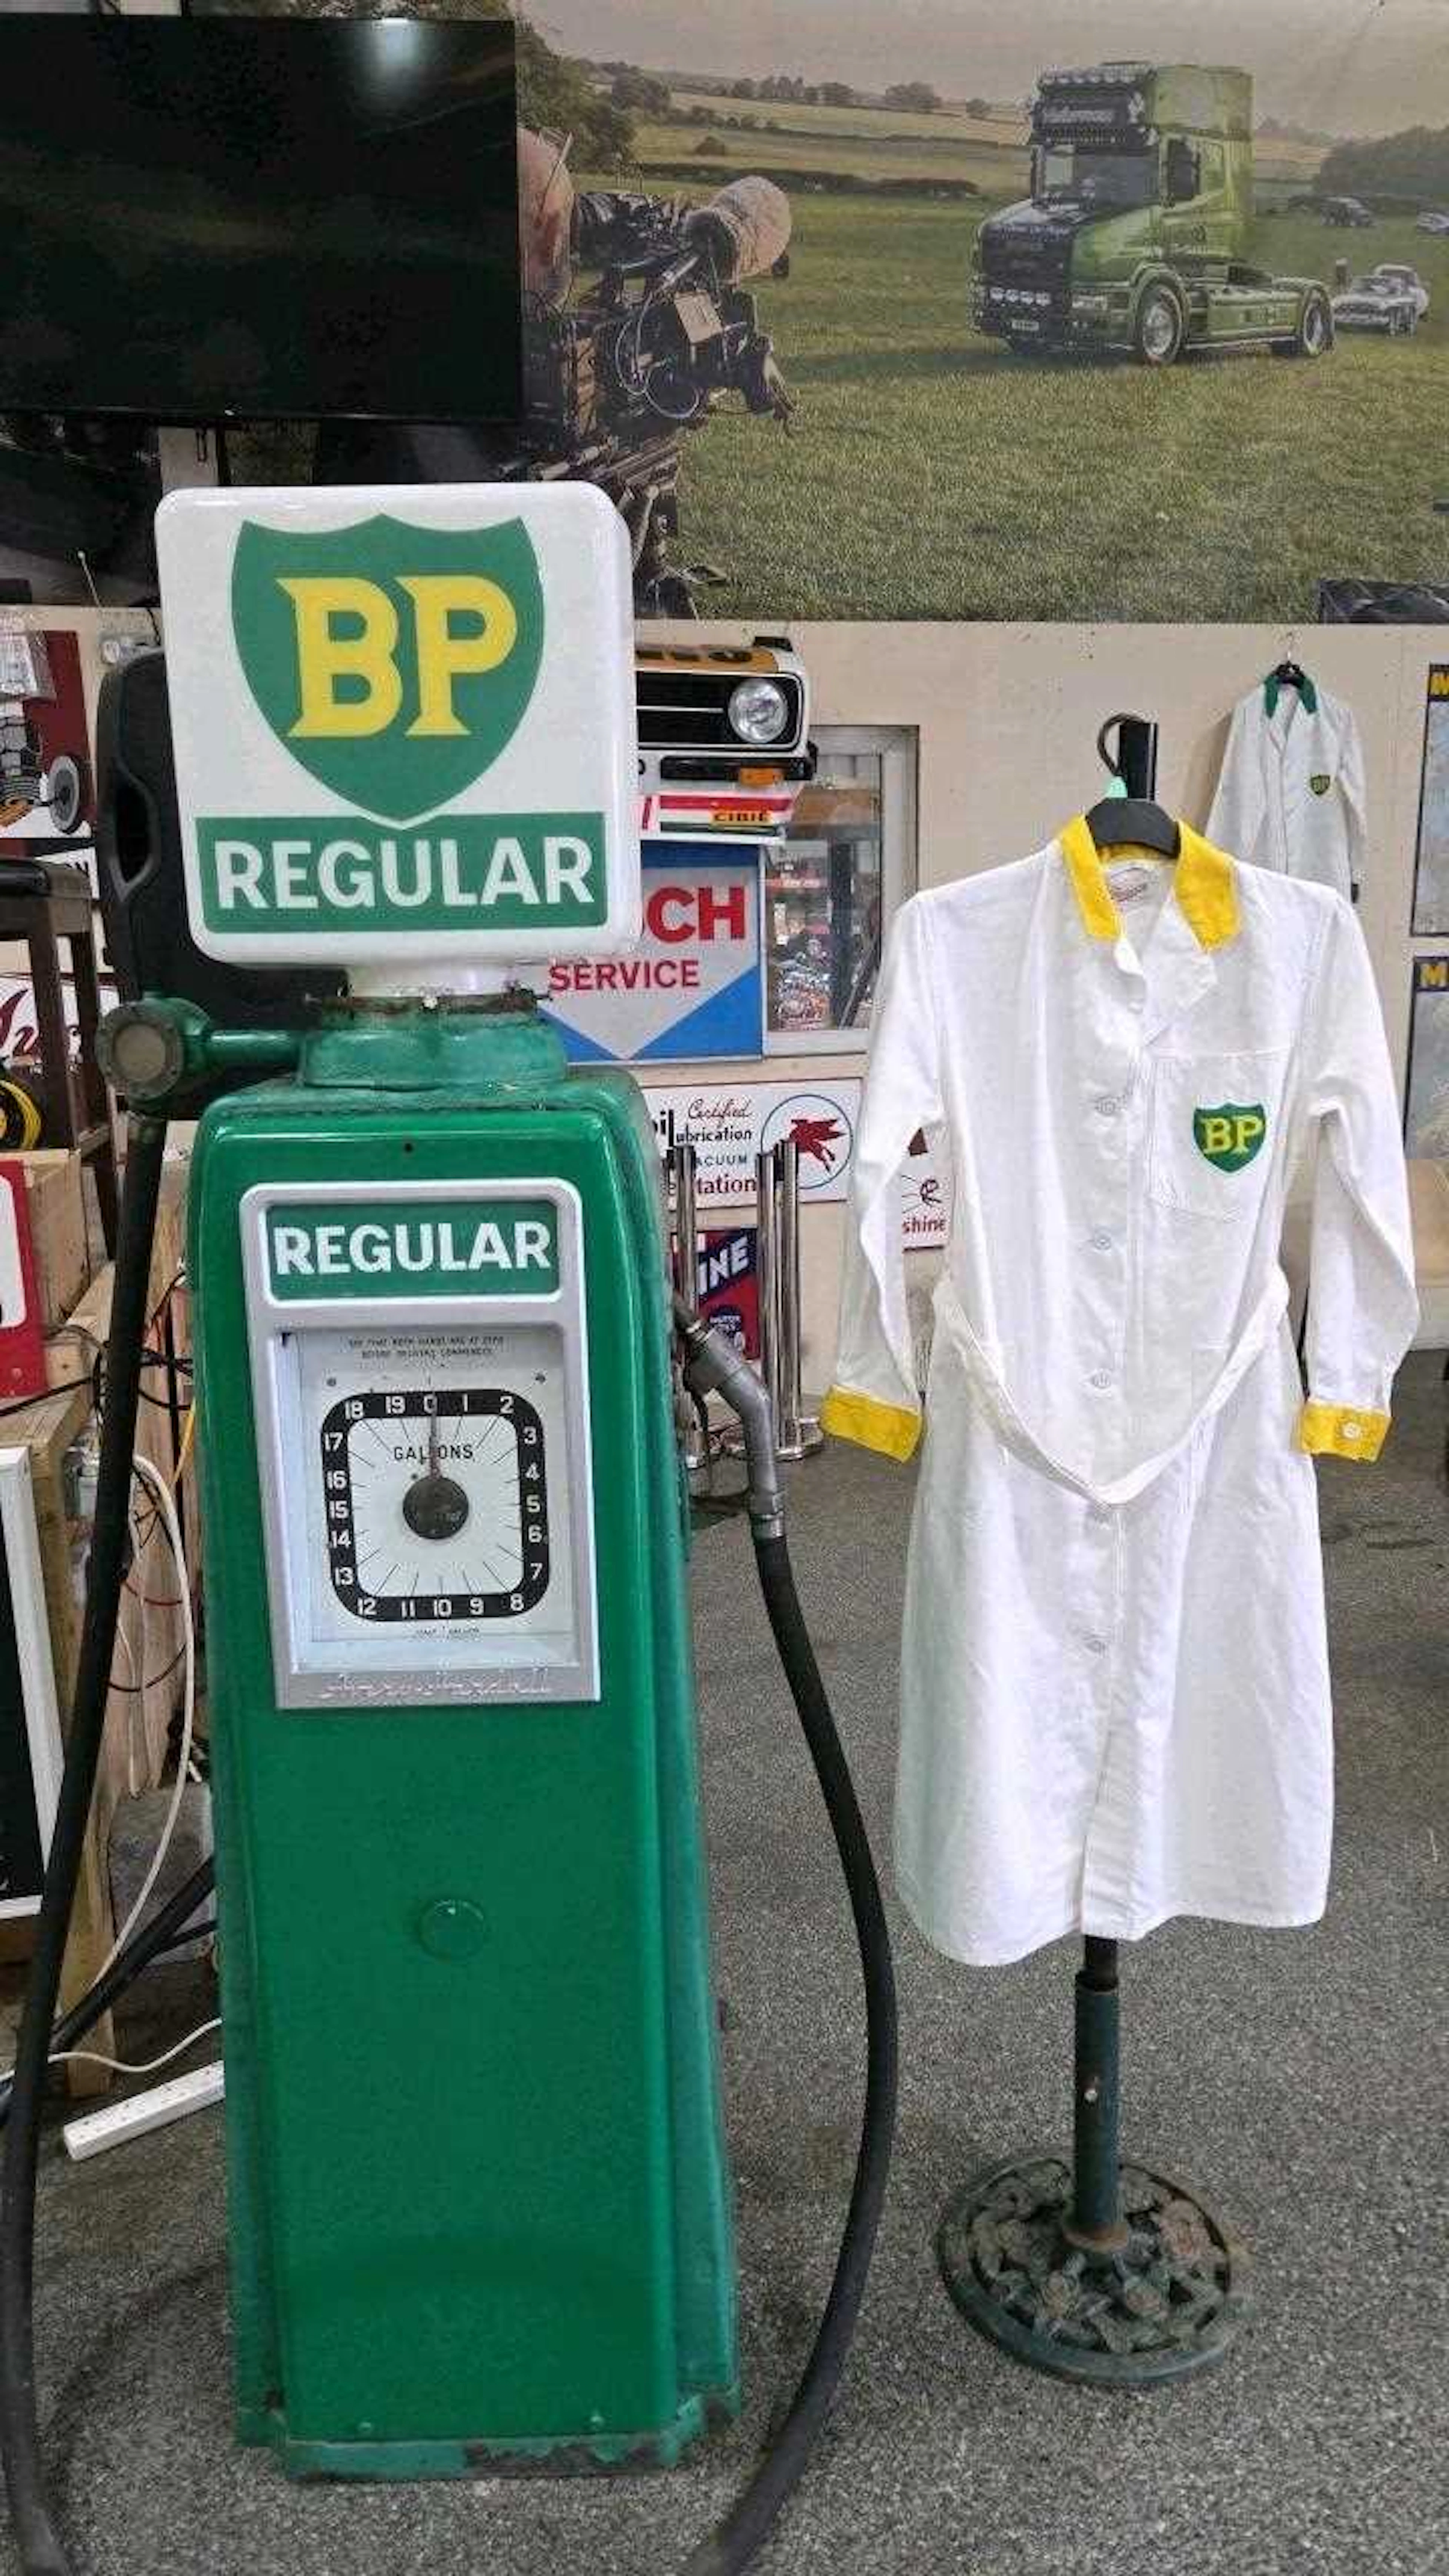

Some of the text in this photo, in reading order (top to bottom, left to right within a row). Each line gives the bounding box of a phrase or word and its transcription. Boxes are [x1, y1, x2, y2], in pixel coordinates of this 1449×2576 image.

[275, 575, 517, 737] BP
[214, 836, 594, 908] REGULAR
[647, 886, 745, 943] CH
[548, 960, 700, 992] SERVICE
[688, 1098, 752, 1121] Certified
[1200, 1115, 1263, 1154] BP
[695, 1153, 746, 1165] ACUUM
[697, 1174, 756, 1193] tation
[274, 1222, 551, 1275] REGULAR
[699, 1236, 749, 1295] INE
[345, 1399, 364, 1419] 18
[385, 1396, 406, 1414] 19
[423, 1395, 437, 1413] 0
[463, 1394, 468, 1411] 1
[500, 1396, 514, 1413] 2
[325, 1432, 343, 1450] 17
[524, 1427, 537, 1444] 3
[394, 1444, 474, 1461] GALONS
[327, 1470, 346, 1489] 16
[526, 1463, 540, 1480] 4
[329, 1501, 348, 1518] 15
[527, 1495, 540, 1512] 5
[332, 1530, 351, 1548] 14
[529, 1526, 541, 1543] 6
[335, 1567, 354, 1585] 13
[530, 1563, 543, 1580] 7
[357, 1598, 376, 1615] 12
[401, 1600, 415, 1618] 11
[434, 1598, 452, 1616] 10
[470, 1597, 484, 1615] 9
[510, 1593, 524, 1611] 8
